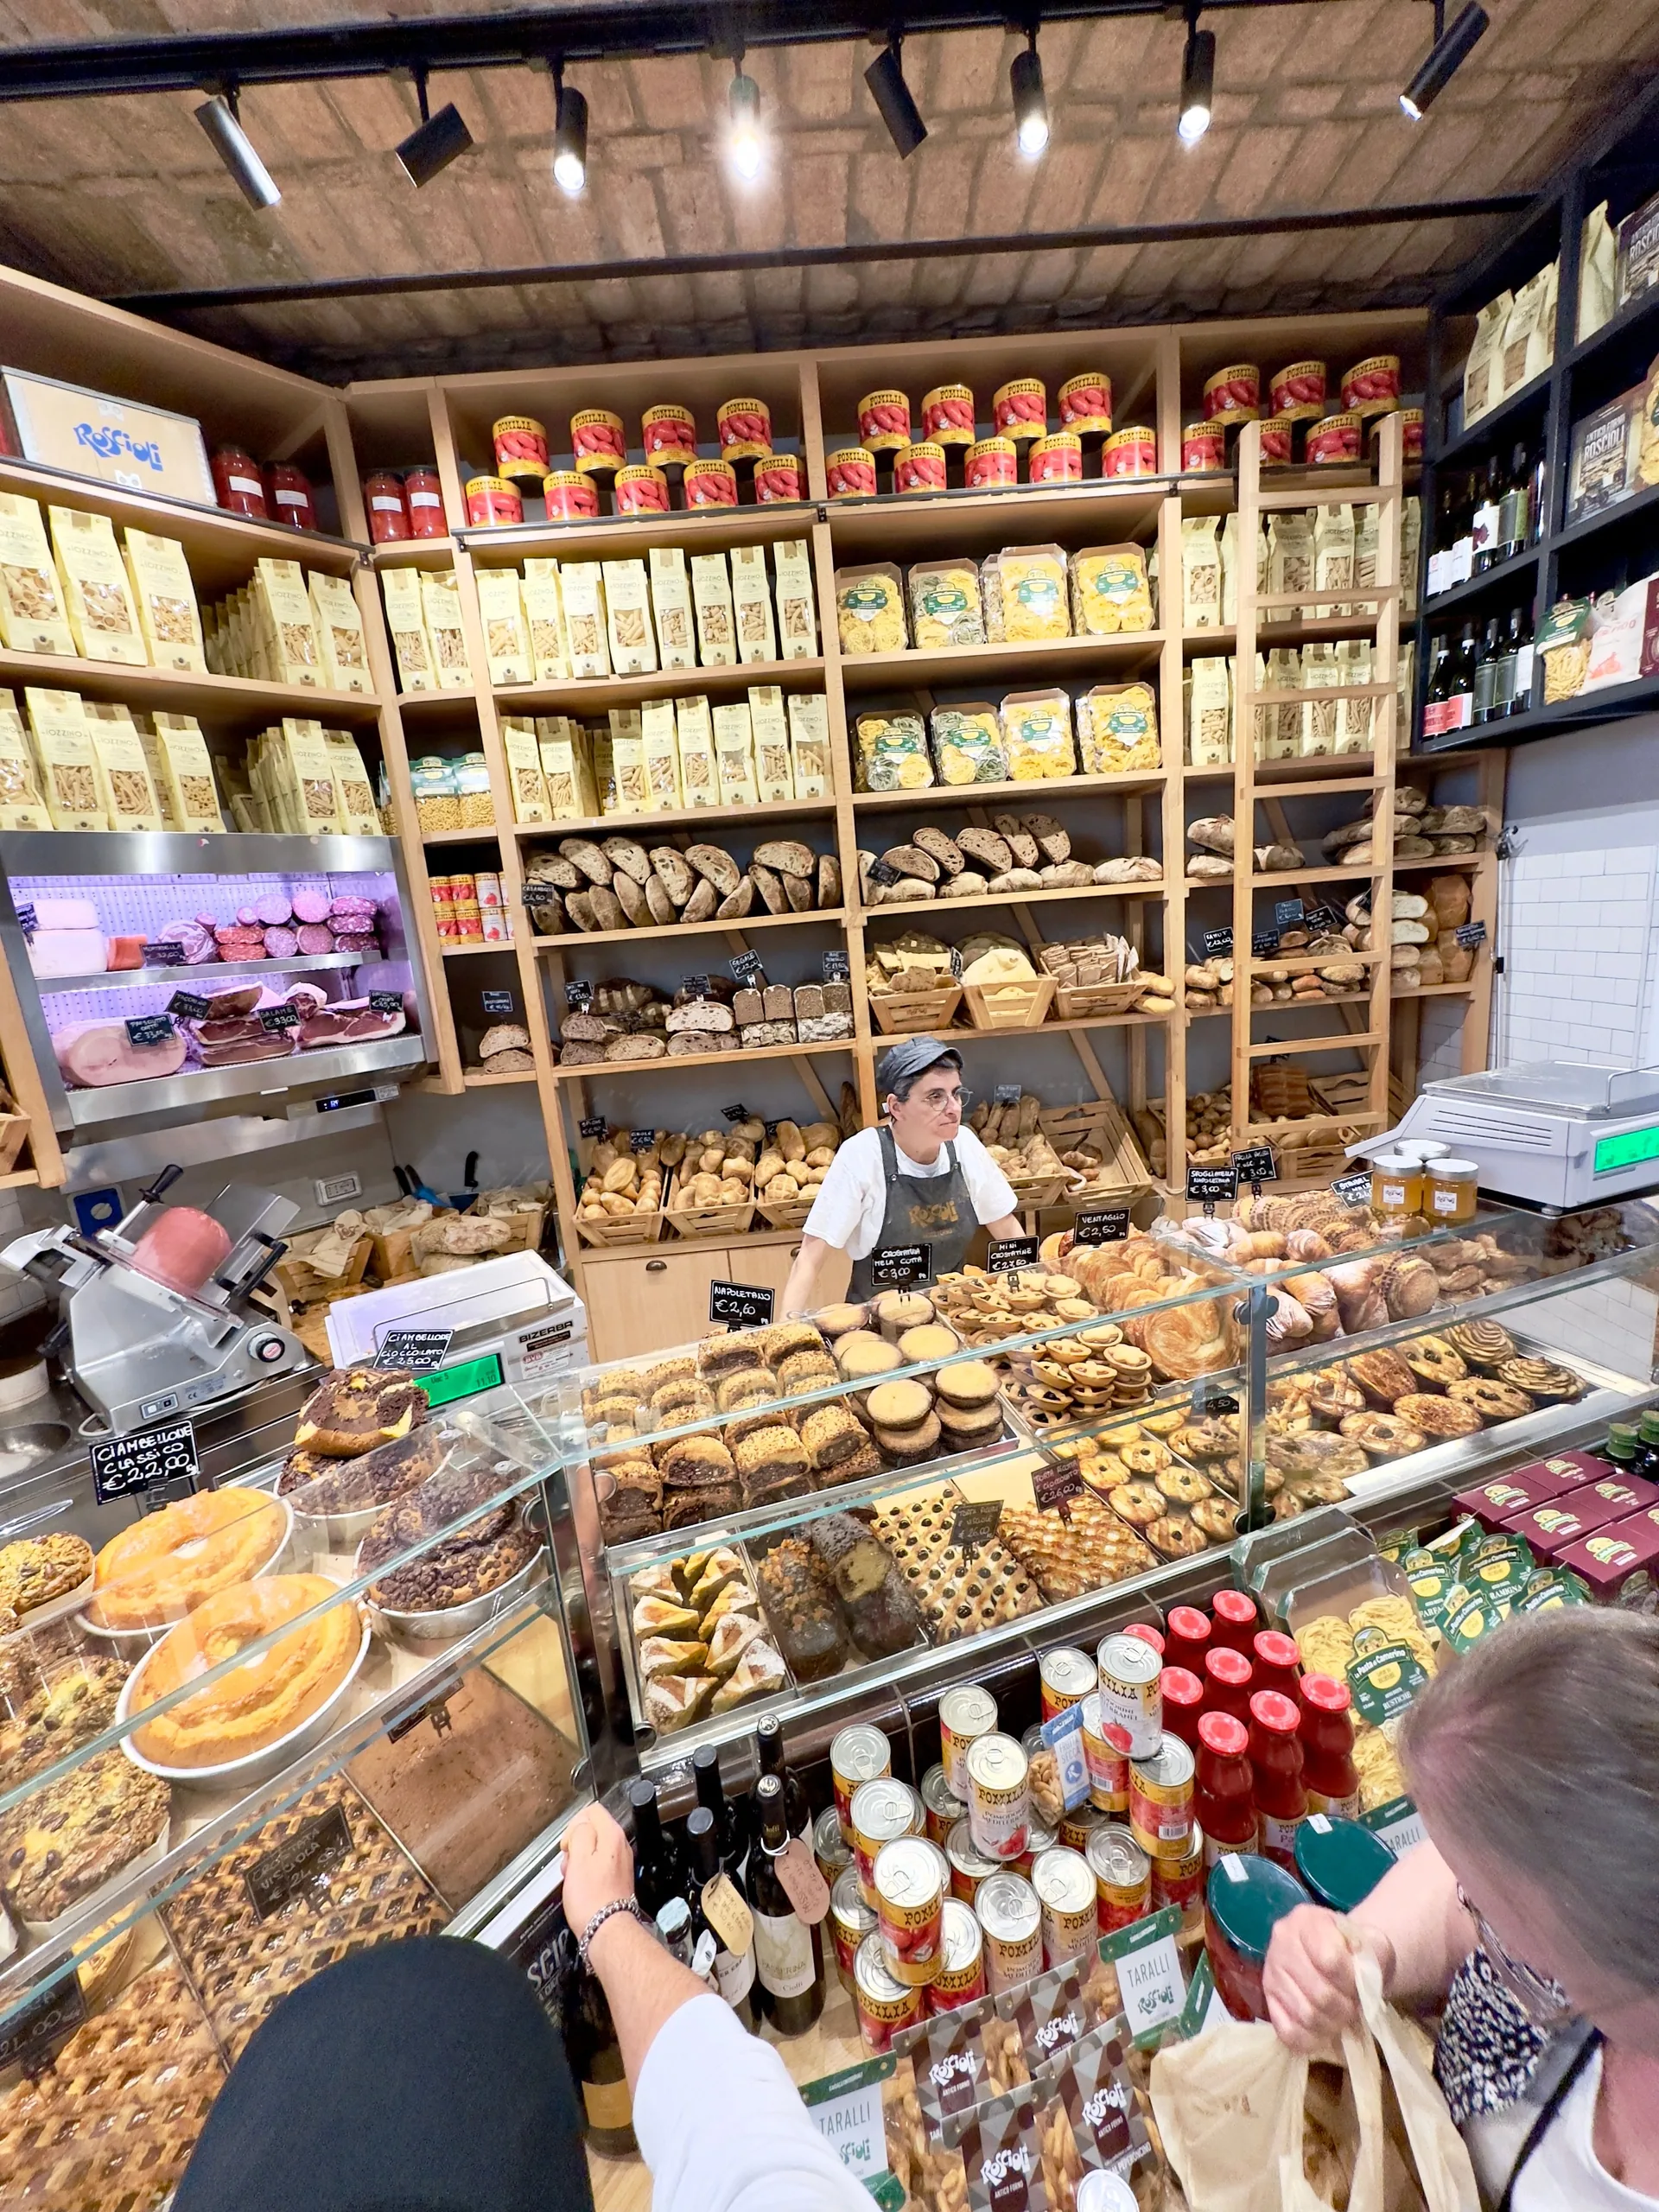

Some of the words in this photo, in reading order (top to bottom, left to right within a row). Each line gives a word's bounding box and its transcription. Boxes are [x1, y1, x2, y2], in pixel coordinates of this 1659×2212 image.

[1007, 384, 1040, 396] POMILIA
[1066, 378, 1101, 393] POMILIA
[869, 394, 903, 406] POMILIA
[940, 389, 971, 401] POMILIA
[652, 409, 686, 421] POMILIA
[727, 403, 760, 415] POMILIA
[498, 416, 532, 432] POMILIA
[575, 413, 608, 428] POMILIA
[1118, 431, 1151, 445] POMILIA
[1584, 423, 1625, 462] ROSCIOLI
[837, 452, 870, 463] POMILIA
[910, 447, 943, 458] POMILIA
[695, 461, 728, 474] POMILIA
[761, 458, 795, 471] POMILIA
[621, 468, 654, 480] POMILIA
[732, 952, 755, 967] SEGALE
[261, 1007, 293, 1019] SALAME
[1081, 1212, 1126, 1224] VENTAGLIO
[990, 1248, 1033, 1261] CROSTATINE
[999, 1243, 1018, 1251] MINI
[874, 1258, 895, 1268] MELA
[899, 1255, 923, 1265] COTTA
[714, 1286, 771, 1301] NAPOLETANO
[519, 1320, 574, 1344] BIZERBA
[381, 1348, 444, 1358] CIOCCOLATO
[97, 1426, 194, 1462] CIAMBELLONE
[103, 1442, 184, 1475] CLASSICO
[1033, 1470, 1054, 1483] TORTA
[1491, 1549, 1517, 1564] Camerino
[1419, 1567, 1446, 1577] Camerino
[1489, 1584, 1523, 1600] RAMIGNA
[1538, 1584, 1565, 1601] Camerino
[1463, 1595, 1484, 1617] Camerino
[1357, 1661, 1374, 1676] Pasta
[1376, 1649, 1406, 1664] Camerino
[1382, 1691, 1413, 1711] RUSTICHE
[1127, 1953, 1170, 1988] TARALLI
[782, 1980, 804, 1993] Cioffi
[942, 2084, 957, 2097] ANTICO
[957, 2079, 970, 2093] FORNO
[819, 2101, 871, 2137] TARALLI
[1097, 2126, 1111, 2139] ANTICO
[1110, 2116, 1123, 2131] FORNO
[839, 2137, 871, 2165] scioli
[1118, 2141, 1152, 2171] PEPERONCINO
[995, 2186, 1009, 2200] ANTICO
[1009, 2179, 1024, 2195] FORNO
